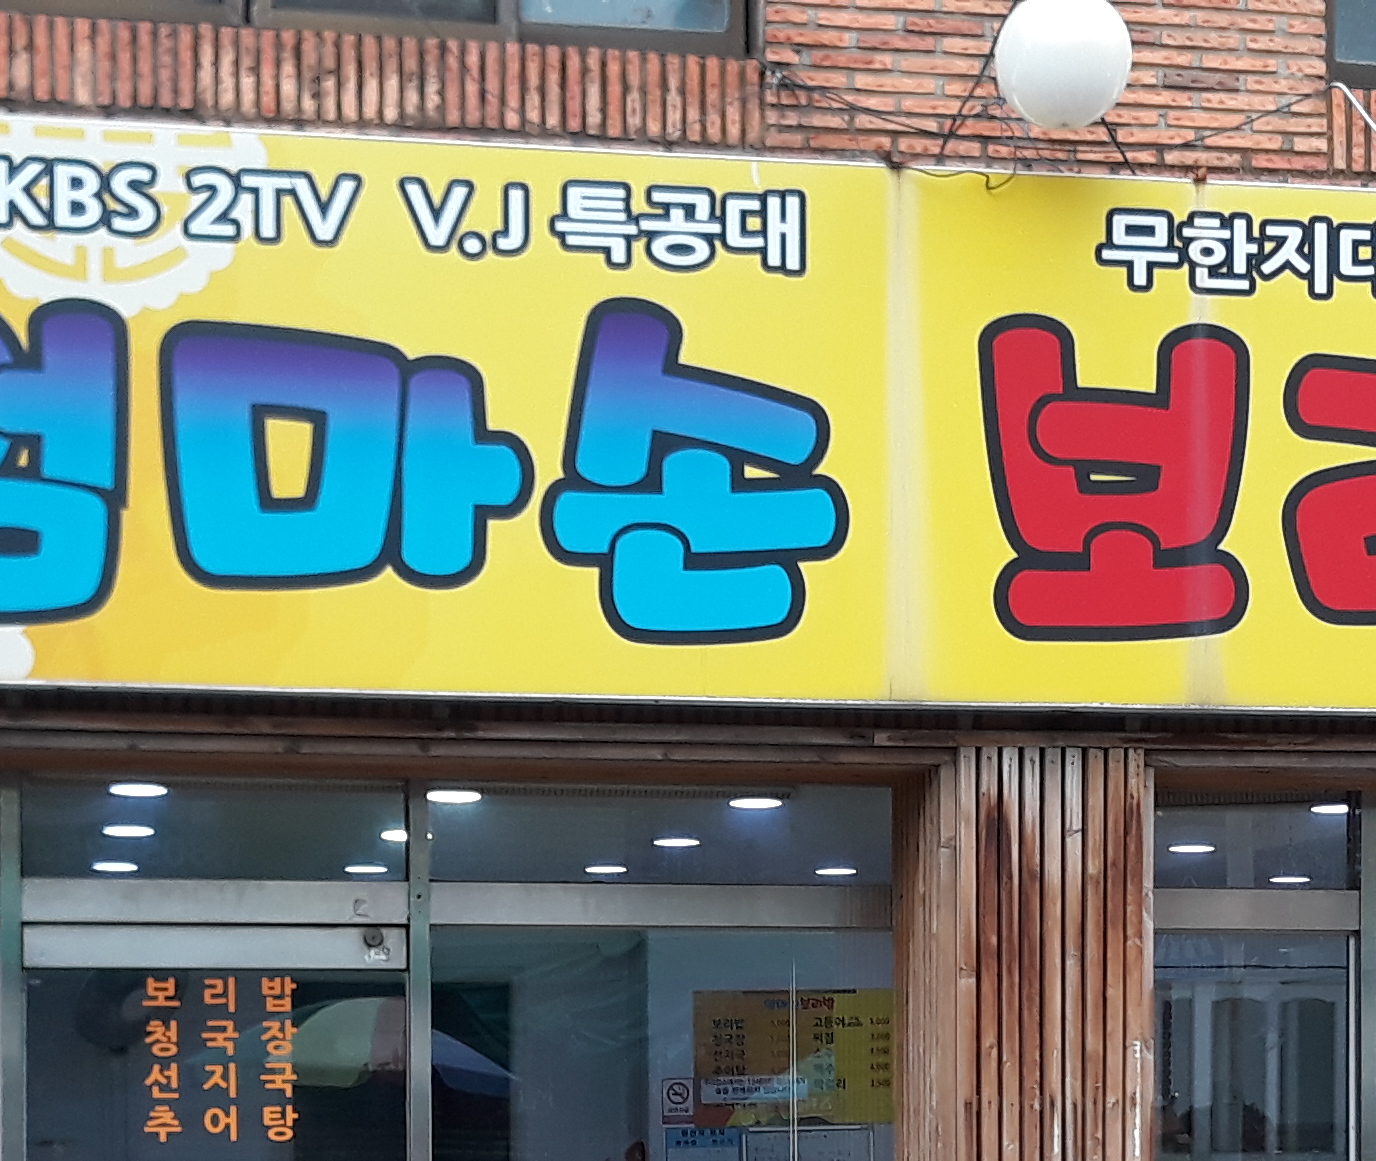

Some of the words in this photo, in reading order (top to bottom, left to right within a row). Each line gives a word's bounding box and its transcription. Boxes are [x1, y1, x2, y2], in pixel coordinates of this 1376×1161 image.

[184, 166, 362, 245] 2TV
[402, 176, 532, 260] V.J
[550, 180, 808, 275] 특공대
[141, 976, 298, 1014] 보리밥
[143, 1019, 299, 1058] 청국장
[143, 1062, 299, 1100] 선지국
[142, 1105, 300, 1143] 추어탕
